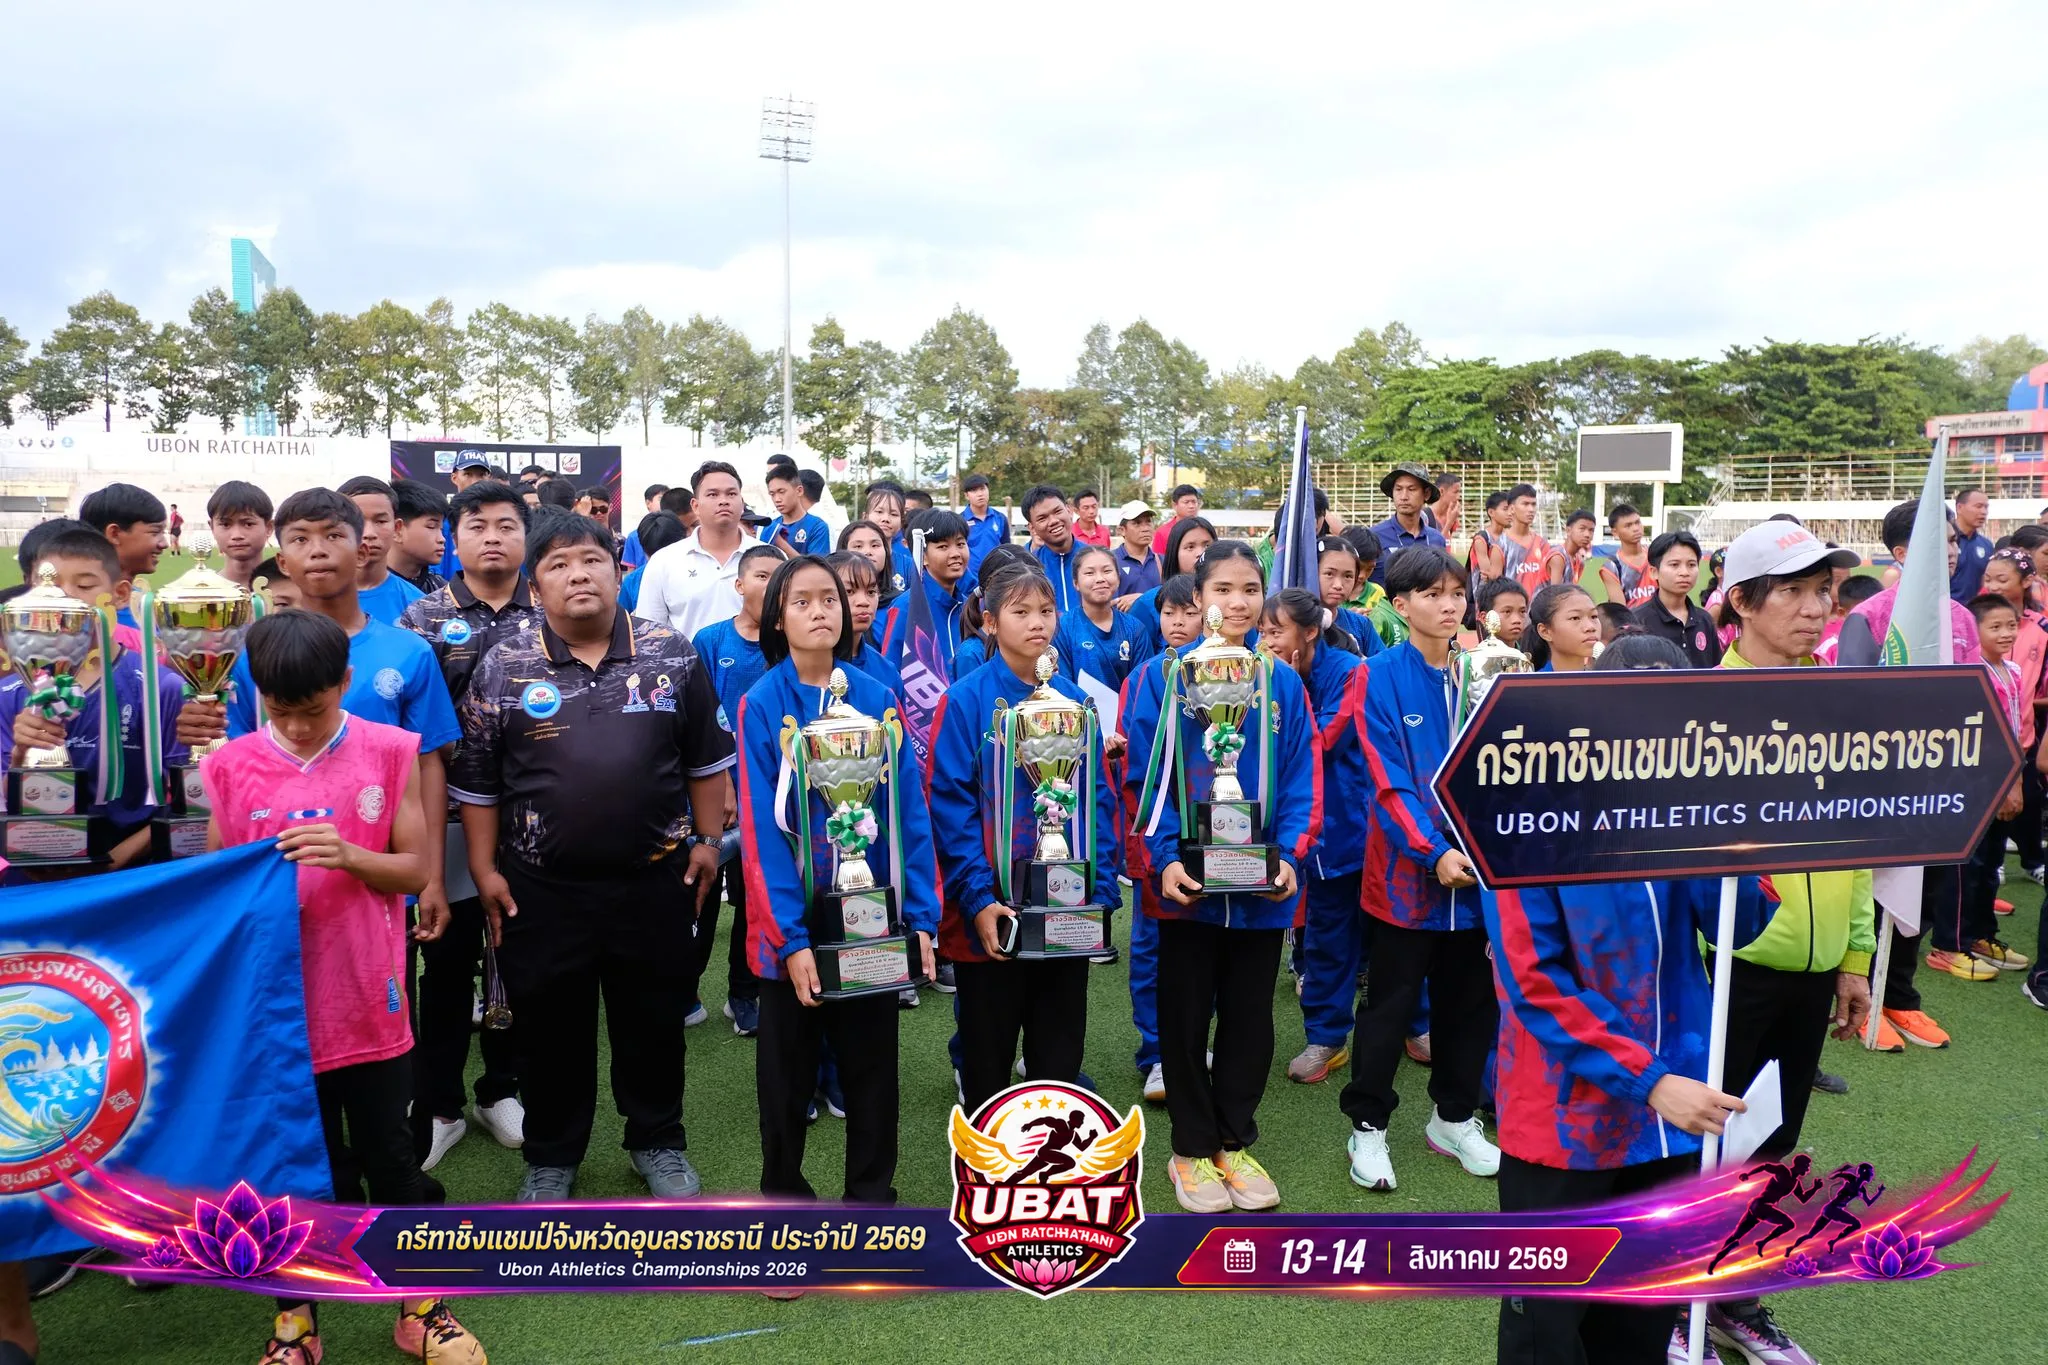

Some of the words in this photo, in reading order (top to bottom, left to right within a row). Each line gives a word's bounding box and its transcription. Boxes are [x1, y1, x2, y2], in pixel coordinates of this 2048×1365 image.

[147, 438, 200, 453] UBON
[1516, 562, 1540, 575] KNP
[1629, 586, 1656, 600] KNP
[1477, 711, 1984, 790] กรีฑาชิงแชมป์จังหวัดอุบลราชธานี
[1496, 810, 1581, 835] UBON
[1593, 803, 1748, 831] ATHLETICS
[1759, 793, 1966, 824] CHAMPIONSHIPS
[0, 957, 133, 1060] พิบูลมังสาหาร
